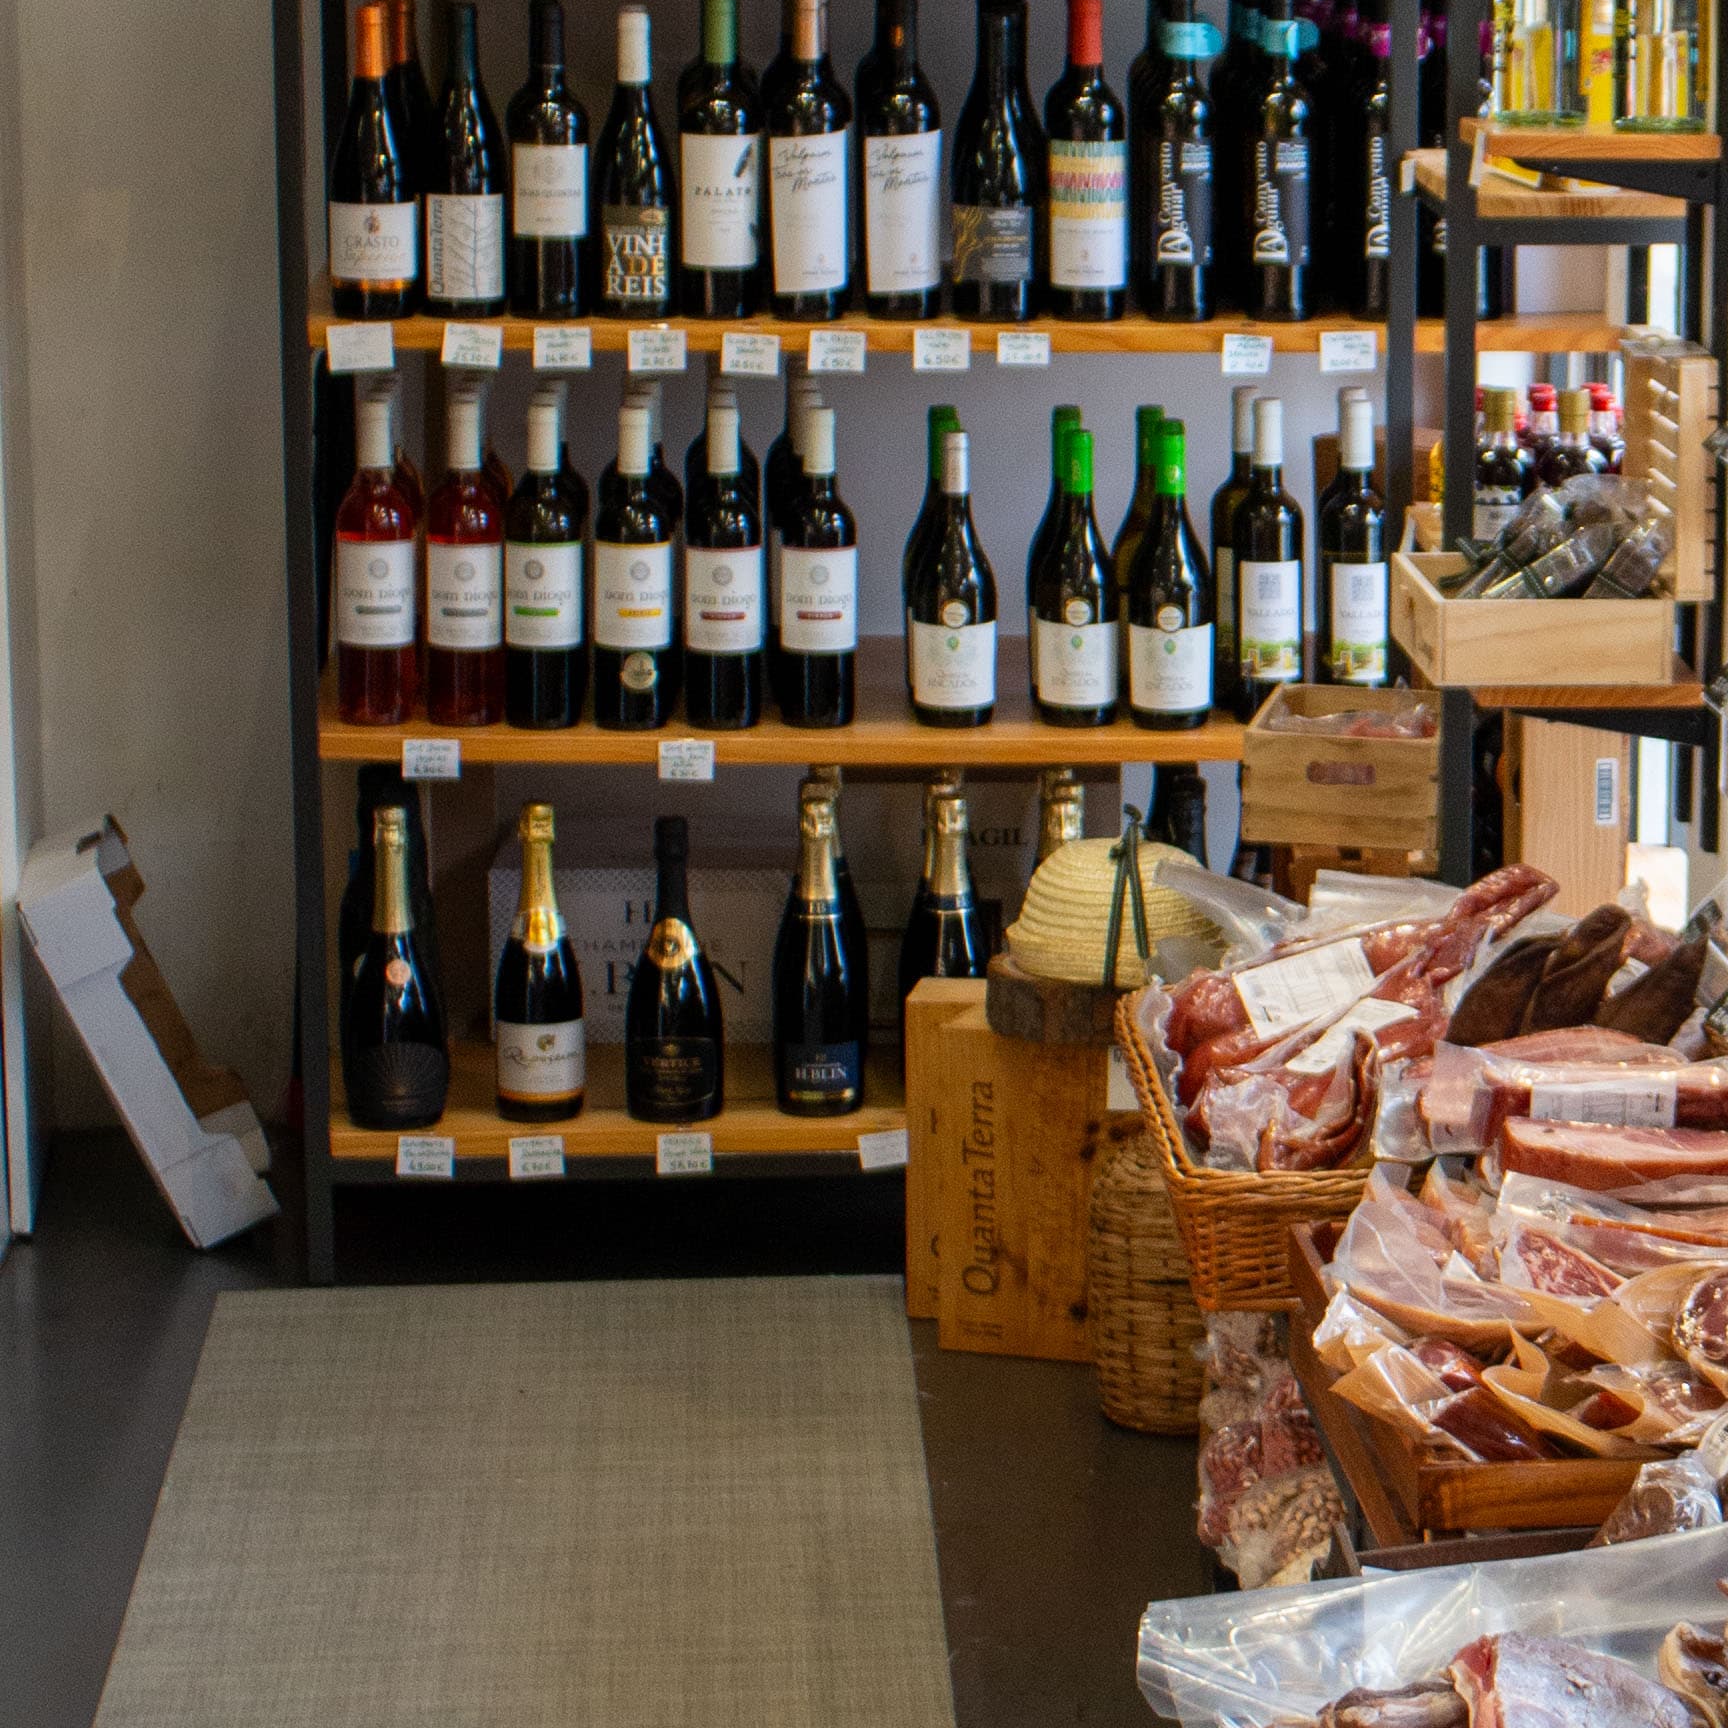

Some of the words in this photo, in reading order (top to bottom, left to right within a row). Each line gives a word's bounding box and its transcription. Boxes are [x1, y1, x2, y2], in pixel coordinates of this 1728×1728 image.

[920, 827, 1027, 846] AGIL
[962, 1080, 994, 1164] Terra
[962, 1170, 1001, 1296] Quanta
